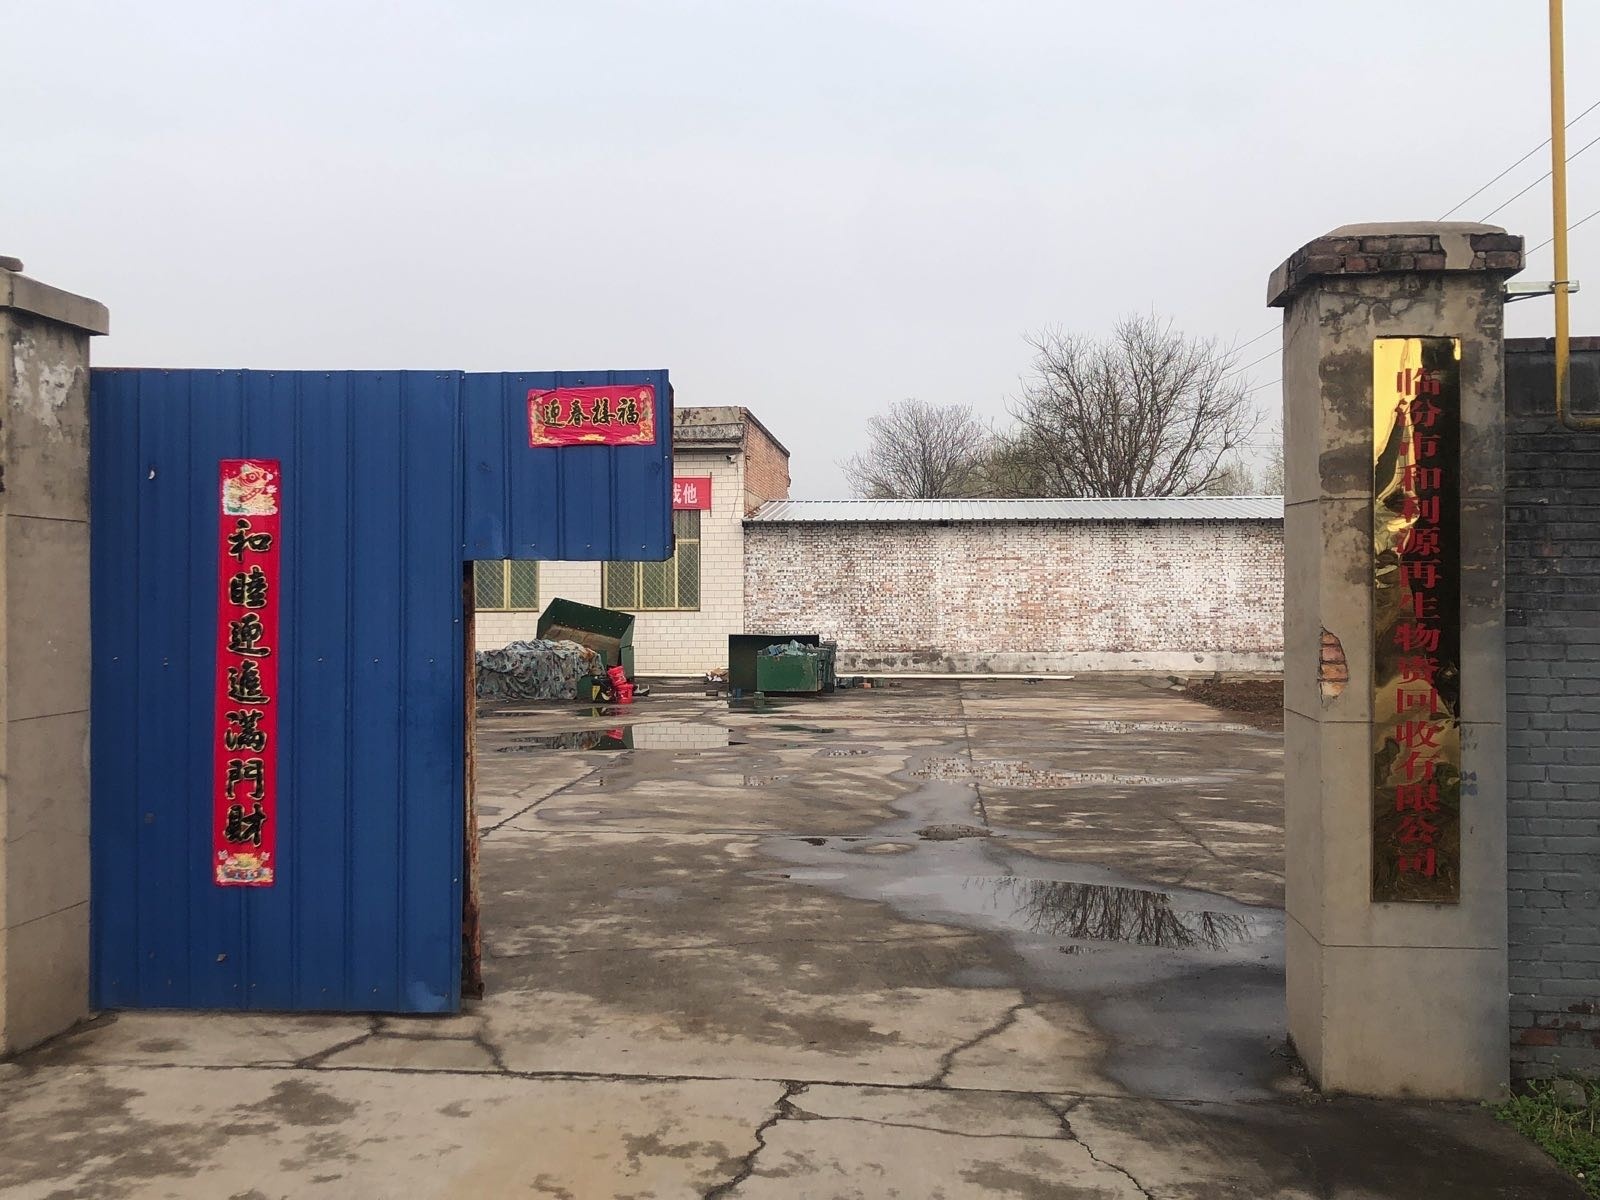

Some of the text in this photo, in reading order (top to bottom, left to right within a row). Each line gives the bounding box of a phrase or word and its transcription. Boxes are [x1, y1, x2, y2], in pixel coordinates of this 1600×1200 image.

[543, 397, 640, 428] 迎春接福
[1393, 367, 1442, 878] 临汾市和利源再生物资回收有限公司
